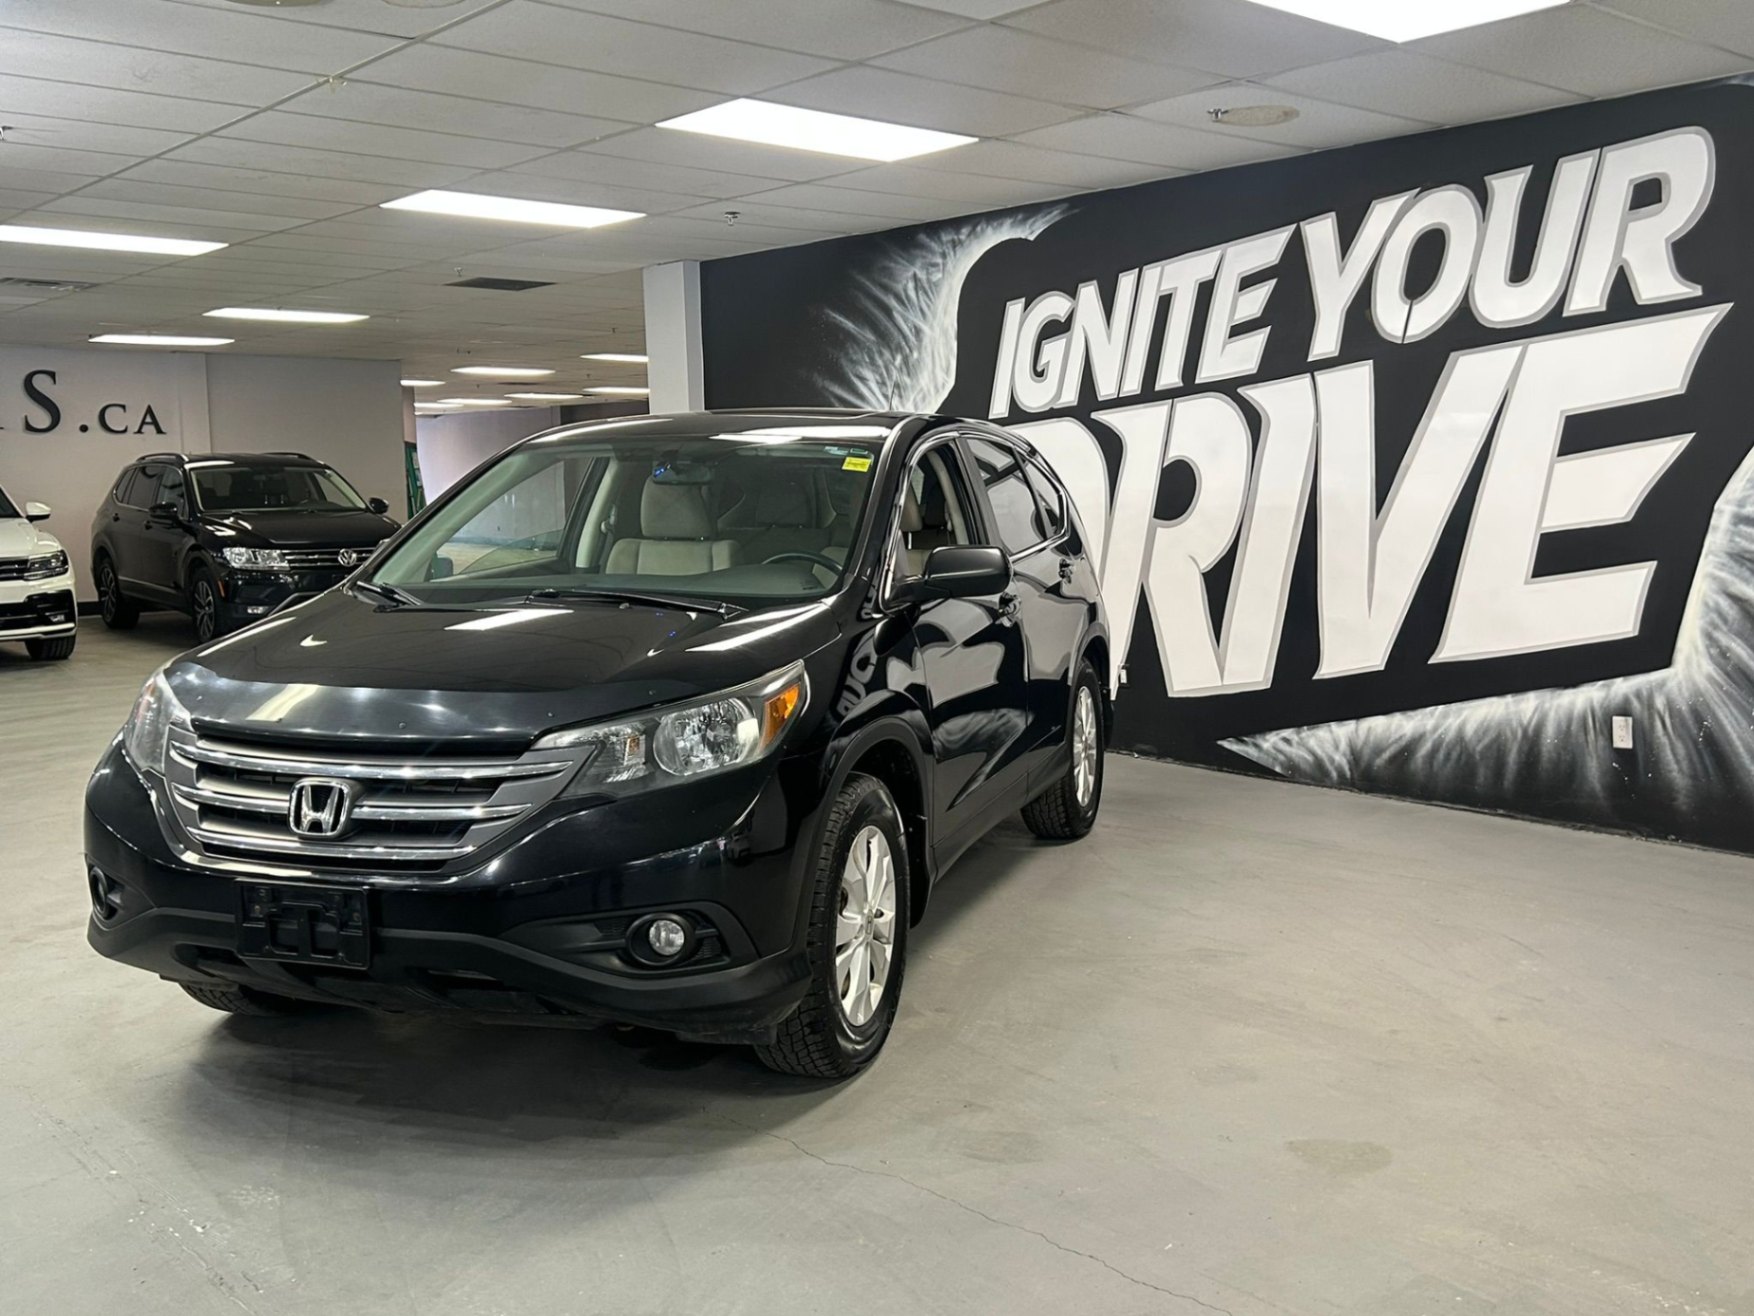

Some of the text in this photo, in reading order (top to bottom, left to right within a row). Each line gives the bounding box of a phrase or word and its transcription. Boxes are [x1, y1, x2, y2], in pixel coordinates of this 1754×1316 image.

[989, 125, 1717, 418] IGNITE YOUR
[0, 369, 167, 434] S.CA
